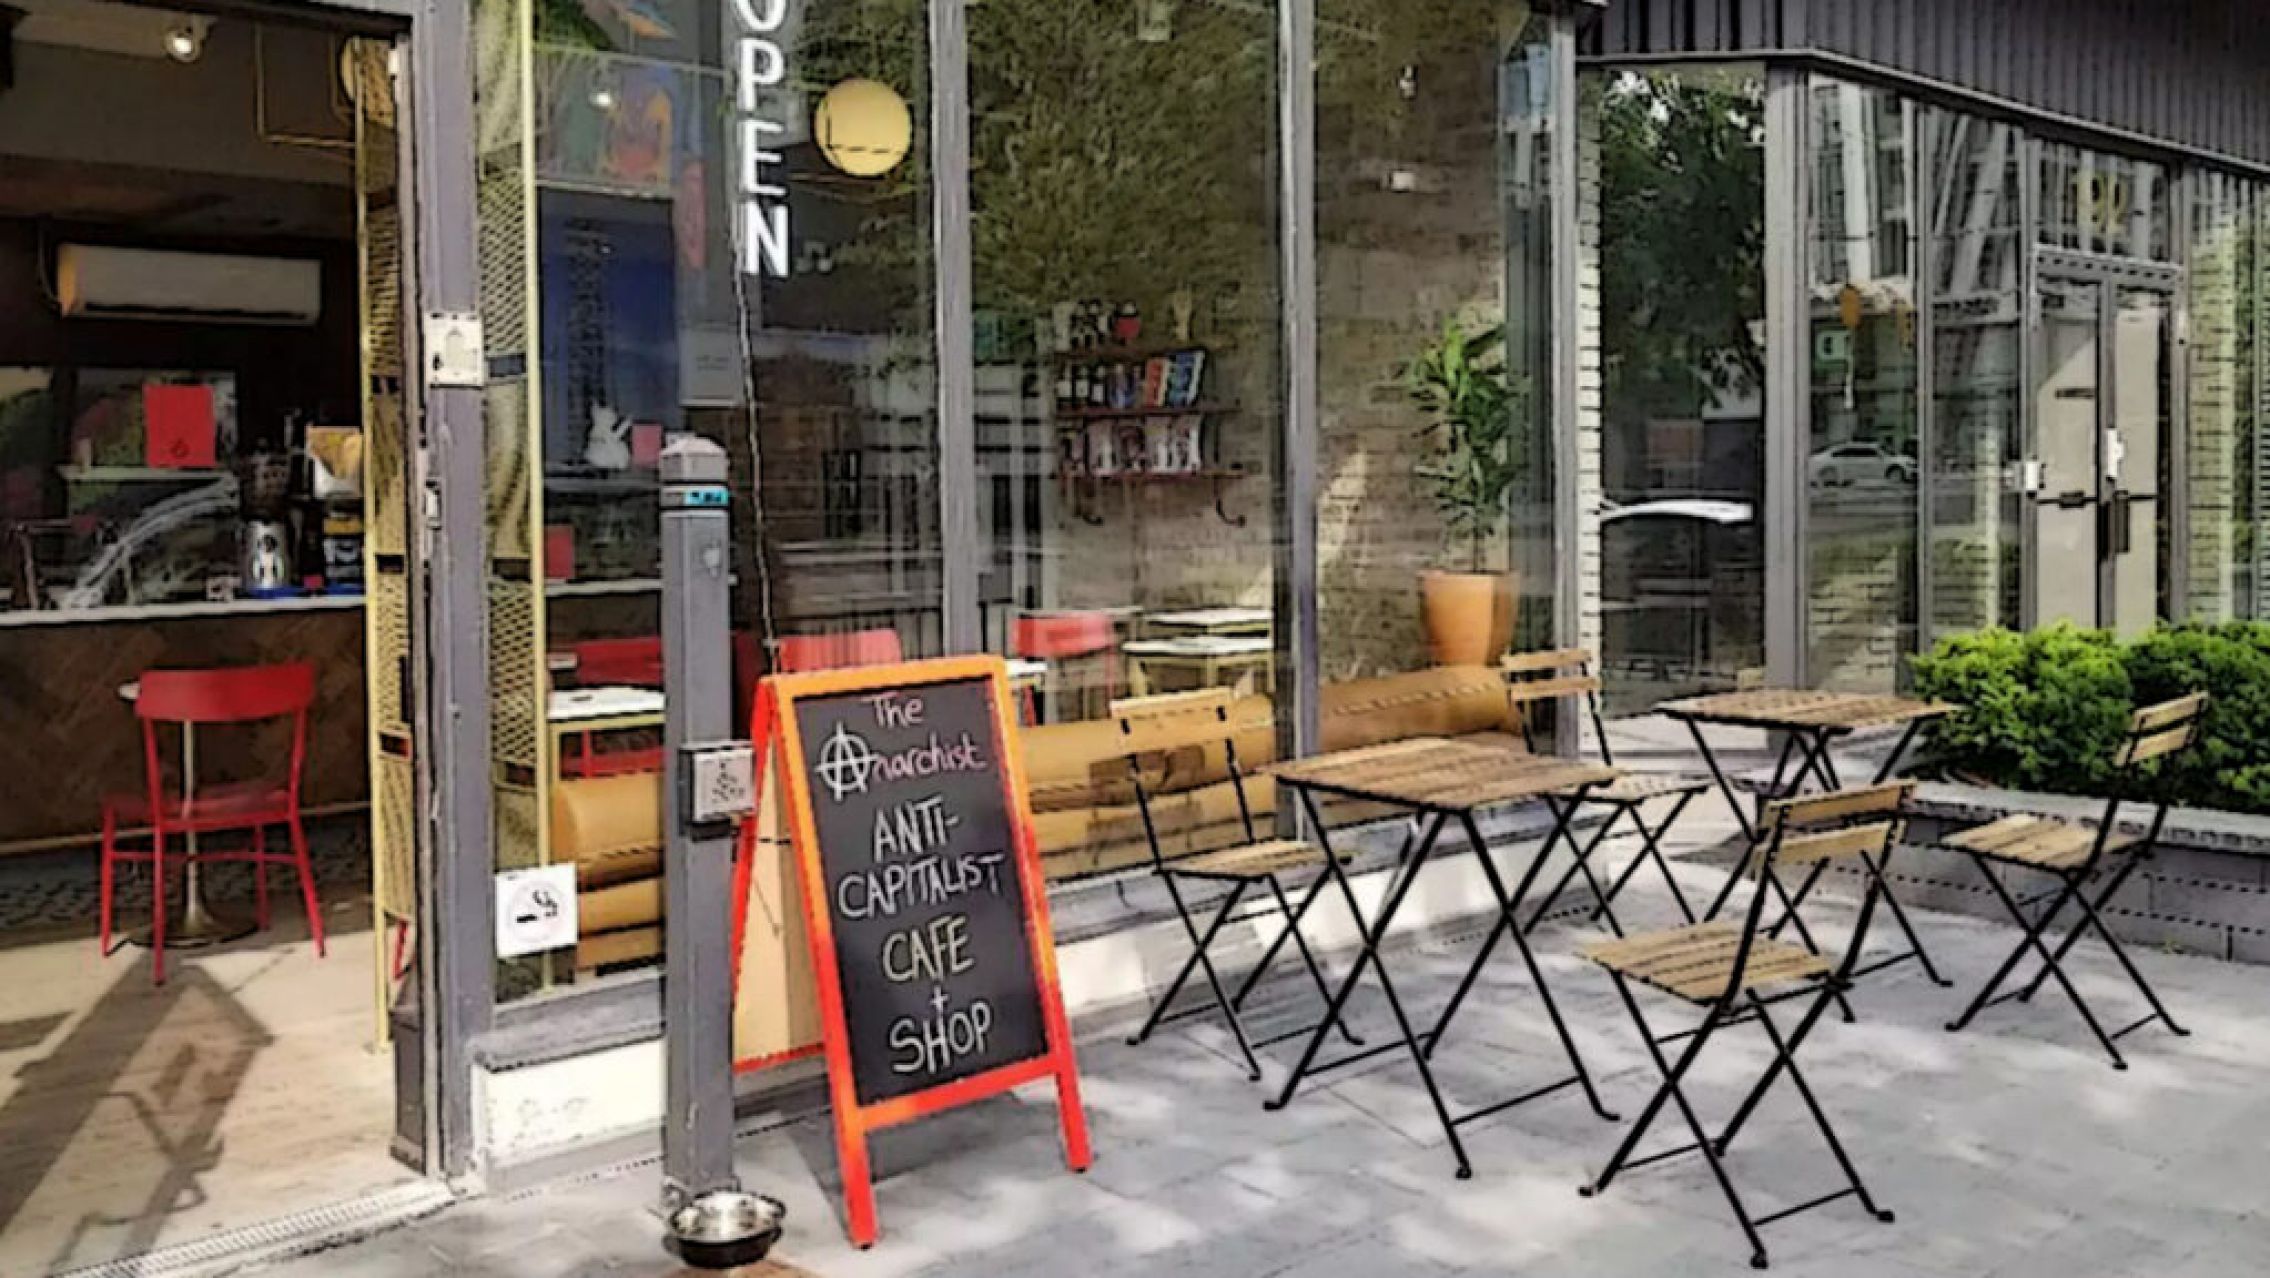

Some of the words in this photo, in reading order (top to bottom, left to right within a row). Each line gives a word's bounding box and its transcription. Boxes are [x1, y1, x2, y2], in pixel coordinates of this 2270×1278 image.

[861, 691, 926, 728] The
[815, 720, 987, 801] Anarchist
[873, 795, 960, 863] ANTI-
[838, 853, 1005, 918] CAPITALIST
[882, 914, 976, 983] CAFE
[929, 984, 949, 1014] +
[888, 1000, 991, 1073] SHOP
